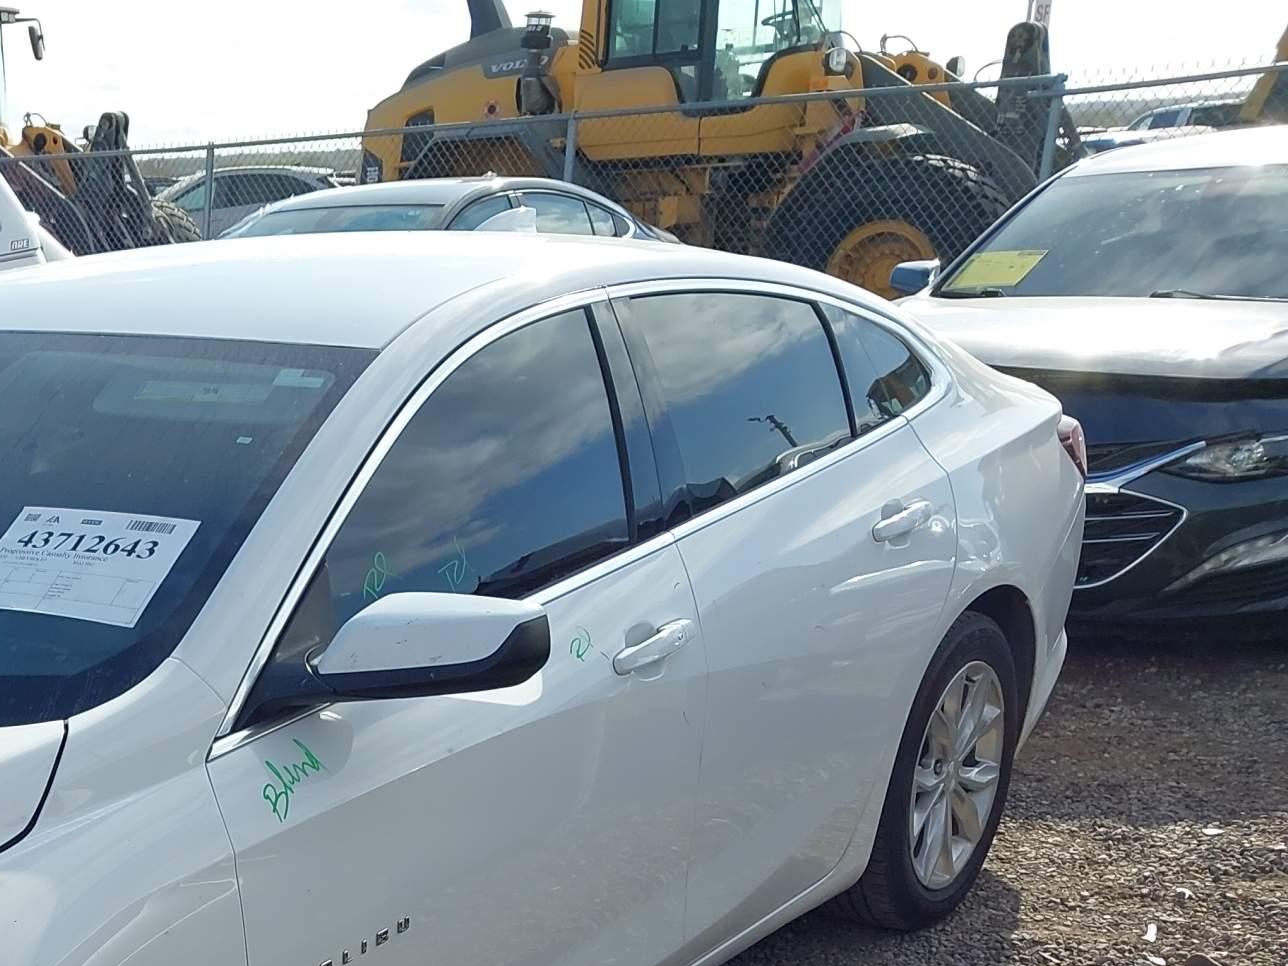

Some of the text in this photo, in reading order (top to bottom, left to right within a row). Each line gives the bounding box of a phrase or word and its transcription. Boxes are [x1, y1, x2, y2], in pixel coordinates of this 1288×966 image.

[491, 55, 549, 72] VOL
[17, 530, 160, 560] 43712643
[0, 547, 40, 557] Progressive
[41, 550, 71, 560] Casualty
[73, 553, 109, 563] Insurance
